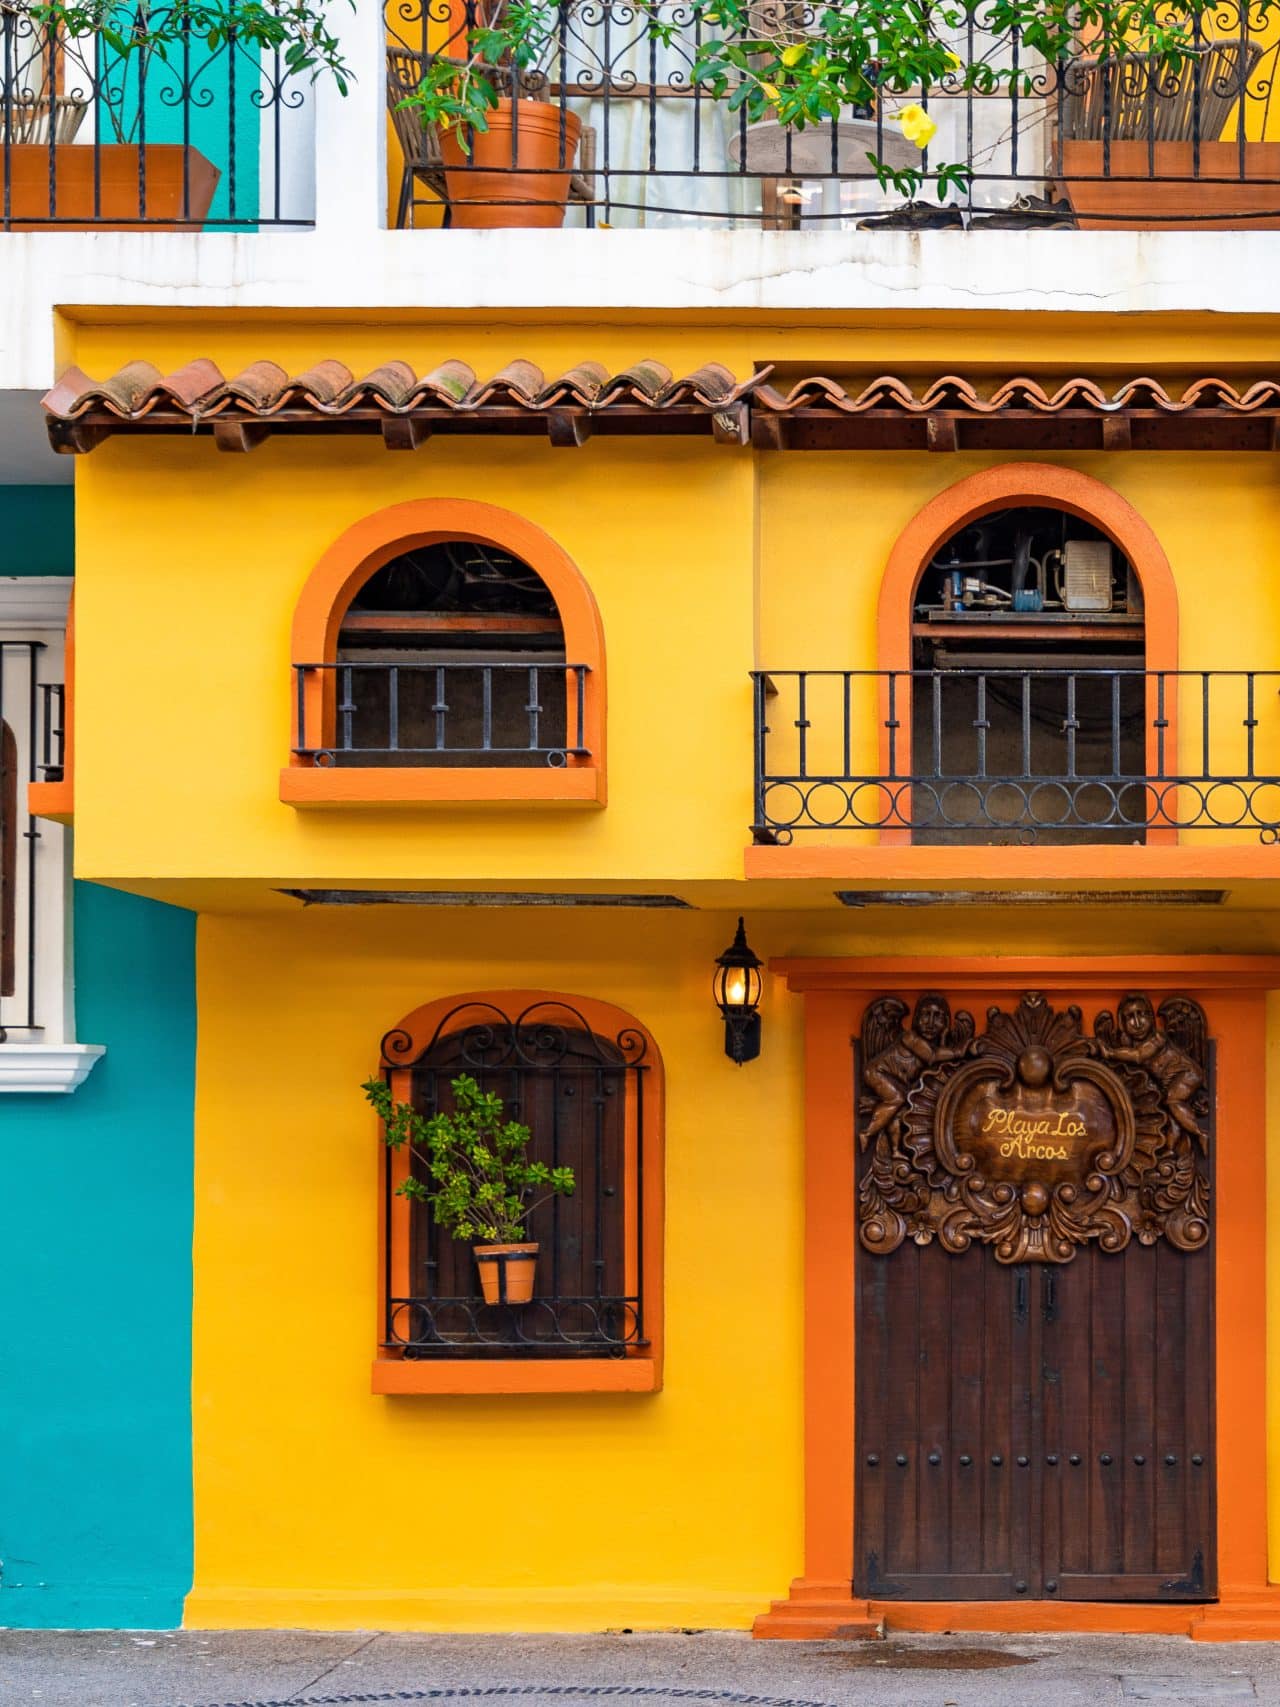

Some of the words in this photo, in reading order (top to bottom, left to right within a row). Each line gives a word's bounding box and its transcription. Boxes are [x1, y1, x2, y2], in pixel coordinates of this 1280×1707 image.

[982, 1108, 1050, 1144] Playa
[1051, 1111, 1088, 1137] Los
[999, 1133, 1070, 1160] Arcos
